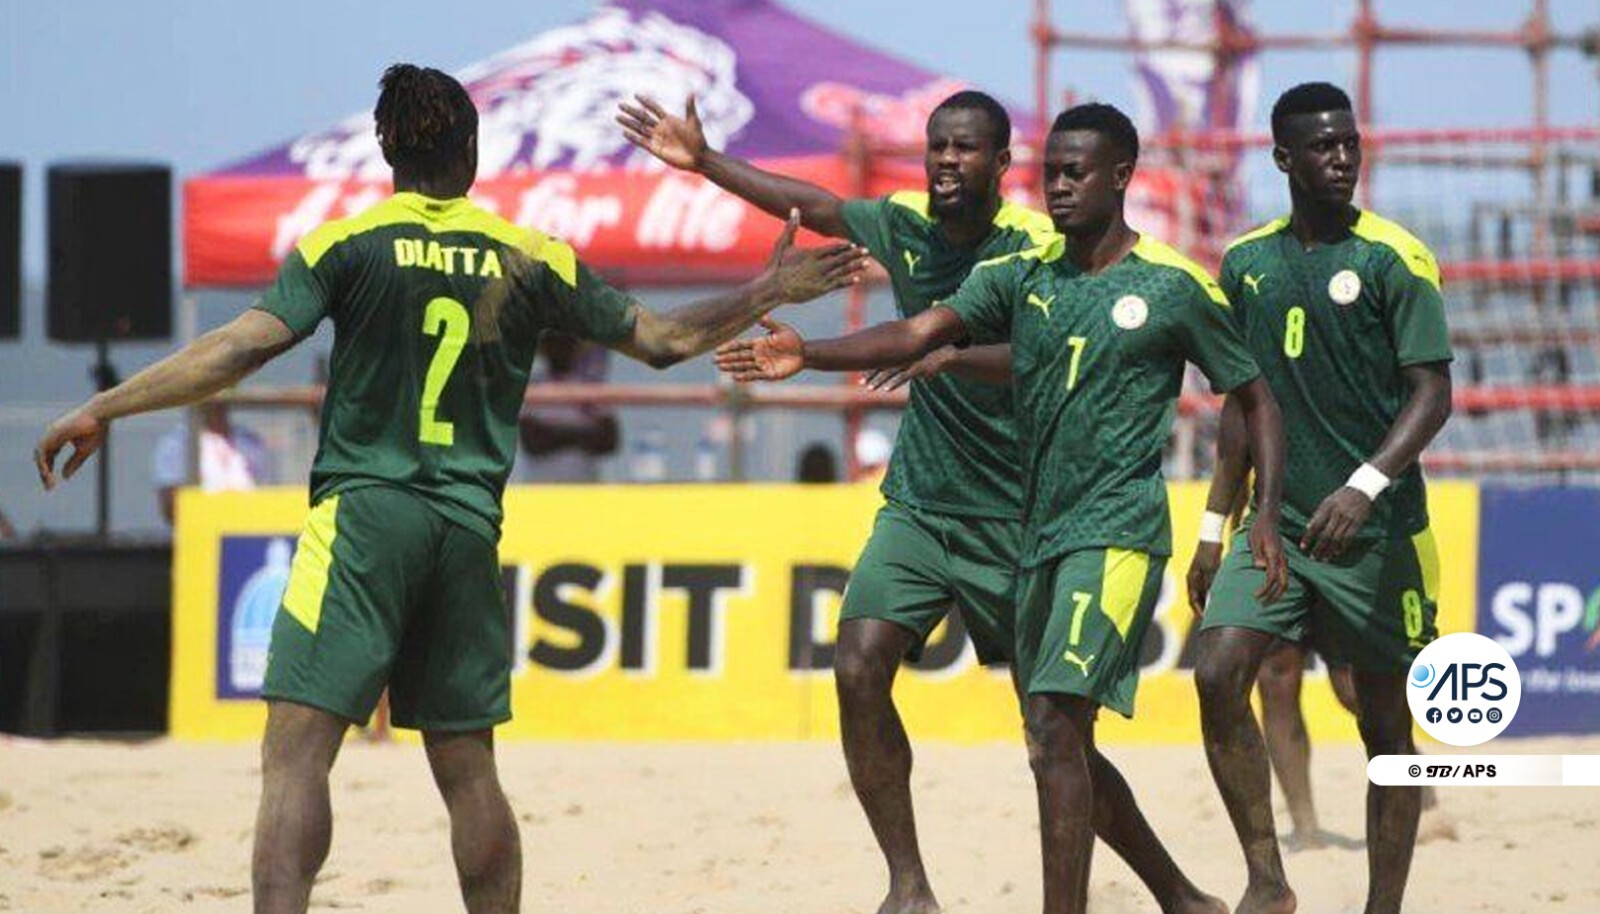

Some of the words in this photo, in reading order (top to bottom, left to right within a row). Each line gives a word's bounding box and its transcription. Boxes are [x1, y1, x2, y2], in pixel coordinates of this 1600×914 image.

[393, 238, 503, 279] DIATTA
[1284, 307, 1306, 358] 8
[418, 296, 471, 445] 2
[1066, 337, 1088, 390] 7
[500, 563, 744, 672] ISIT
[1069, 591, 1093, 646] 7
[1402, 589, 1423, 638] 8
